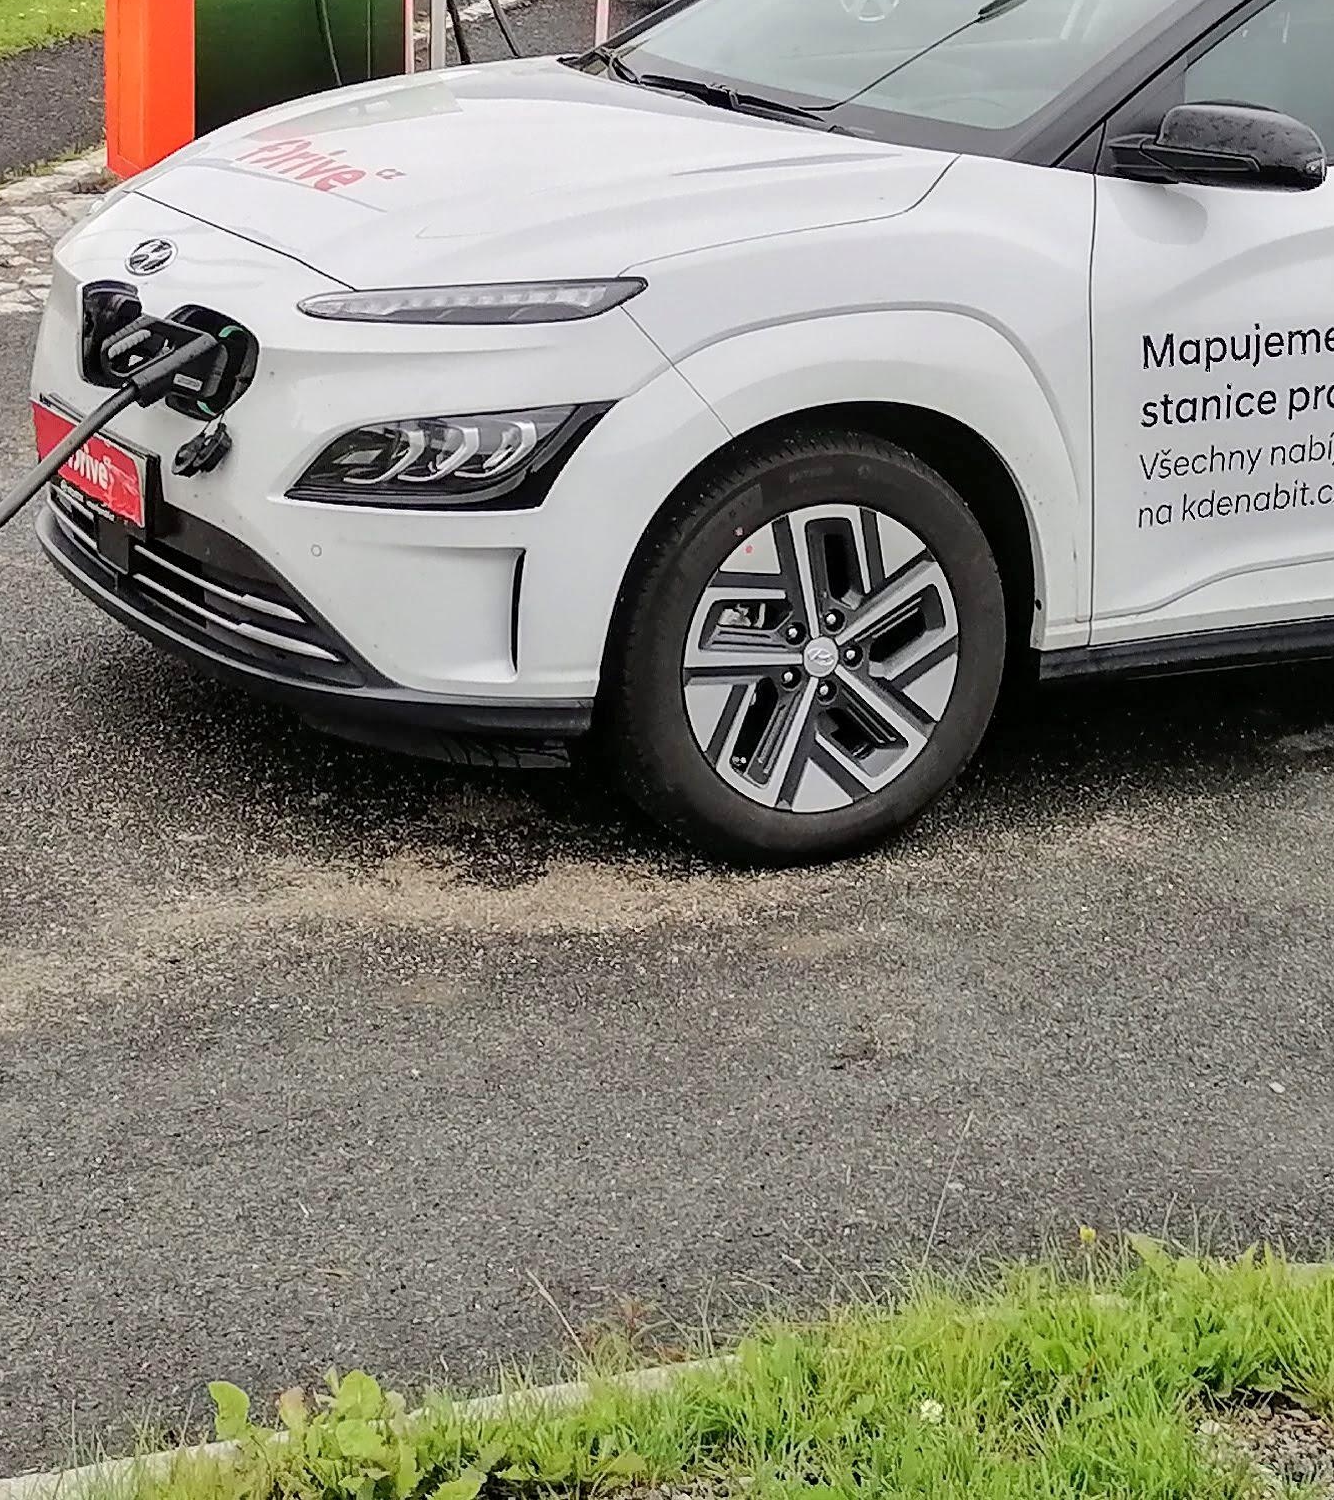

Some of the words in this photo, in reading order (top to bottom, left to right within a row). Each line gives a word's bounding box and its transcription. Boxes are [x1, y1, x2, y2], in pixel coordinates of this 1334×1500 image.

[1139, 384, 1277, 428] stanice
[1139, 443, 1262, 482] Všechny
[1137, 501, 1173, 528] na
